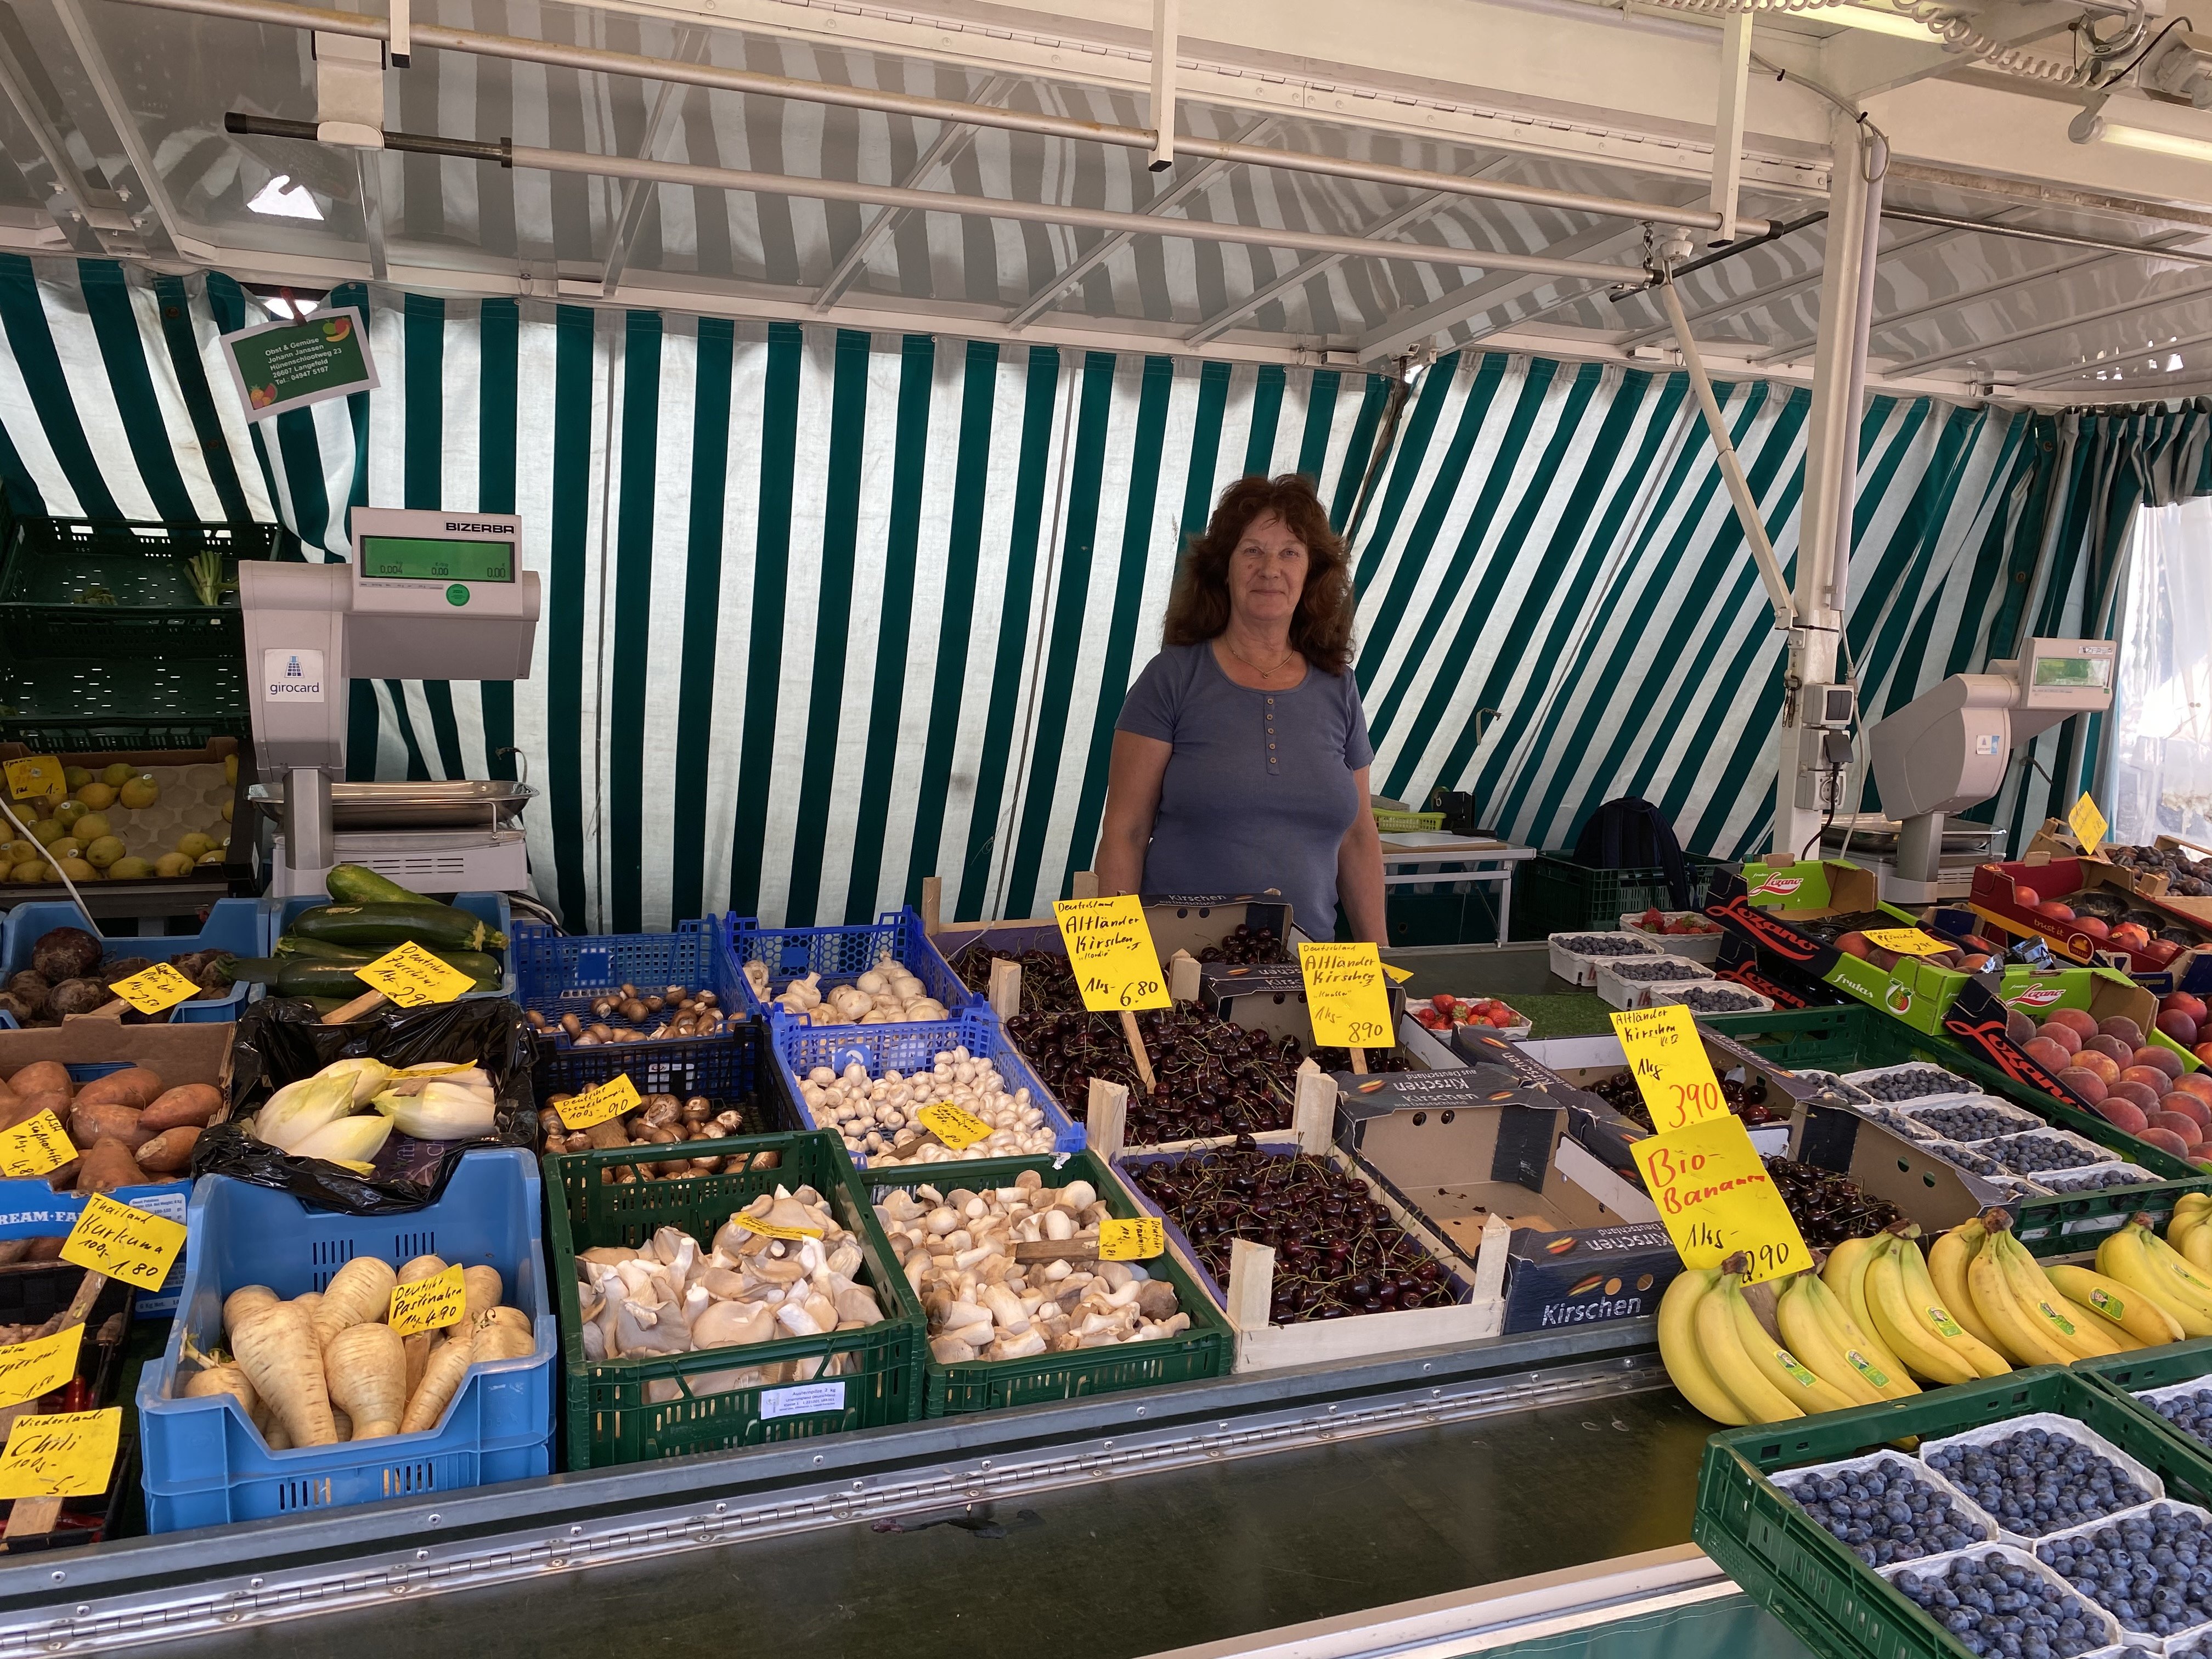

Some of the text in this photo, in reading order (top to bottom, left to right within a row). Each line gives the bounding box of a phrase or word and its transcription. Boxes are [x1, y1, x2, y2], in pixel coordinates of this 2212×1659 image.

[265, 347, 282, 356] Obst
[290, 338, 319, 348] Gemüse
[268, 345, 324, 364] Johann Janssen
[270, 351, 332, 371] Hünenschlootweg
[294, 358, 328, 372] Langefeld
[291, 370, 311, 381] 04947
[445, 522, 515, 534] BIZERBA
[270, 682, 319, 695] girocard
[1748, 872, 1804, 896] Lozano
[1065, 915, 1140, 934] Altländer
[1705, 895, 1821, 961] Lozano
[2034, 918, 2064, 936] trust it
[1076, 932, 1133, 954] Kirschen
[1305, 955, 1376, 972] Altländer
[1313, 970, 1375, 985] Kirschen
[1716, 960, 1813, 1011] Lozan
[1832, 973, 1874, 998] frutas
[1120, 981, 1159, 1006] 6.80
[2005, 983, 2067, 1007] Lozano
[1616, 1008, 1668, 1026] Altländer
[1348, 1022, 1383, 1043] 8.90
[1624, 1023, 1676, 1043] Kirschen
[1405, 1071, 1462, 1081] Deutschland
[1502, 1052, 1555, 1085] Kirschen
[1393, 1077, 1470, 1092] Kirschen
[1401, 1093, 1480, 1102] Kirschen
[1669, 1082, 1718, 1128] 3.90
[1663, 1175, 1765, 1215] Bananen
[94, 1197, 155, 1224] Thailand
[77, 1213, 163, 1254] Kurkuma
[1597, 1223, 1662, 1237] Deutschland
[1585, 1232, 1674, 1251] Kirschen
[108, 1260, 159, 1277] 1.80
[1741, 1242, 1789, 1284] 2.90
[393, 1286, 462, 1319] Pastinaken
[425, 1305, 457, 1327] 4.90
[1542, 1296, 1642, 1332] Kirschen
[10, 1433, 82, 1457] Chili
